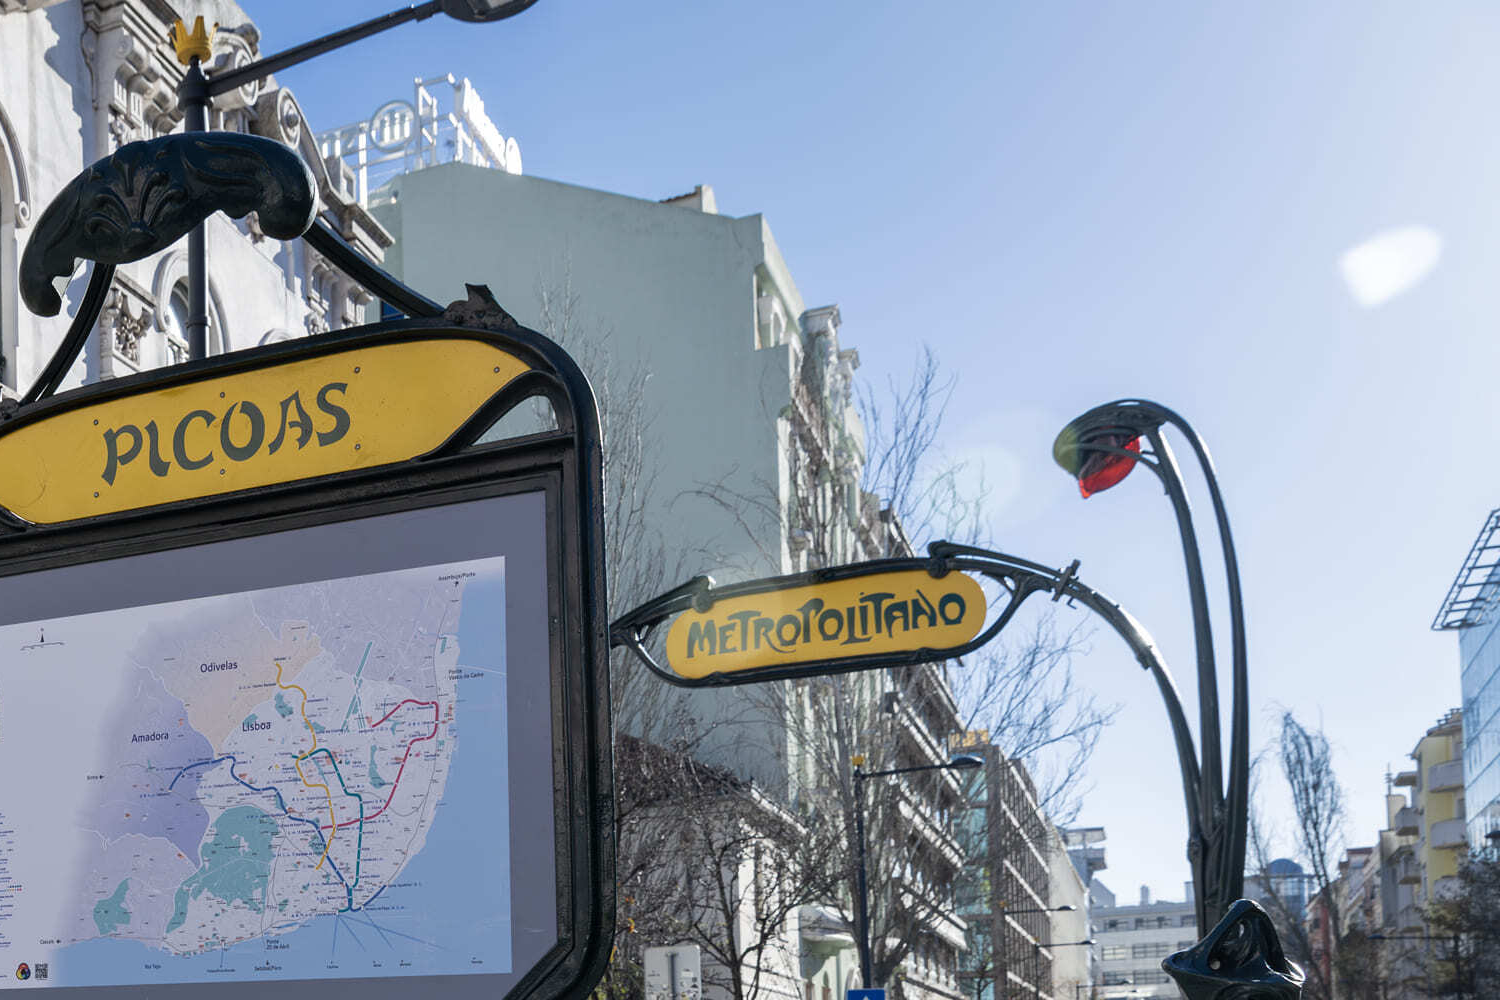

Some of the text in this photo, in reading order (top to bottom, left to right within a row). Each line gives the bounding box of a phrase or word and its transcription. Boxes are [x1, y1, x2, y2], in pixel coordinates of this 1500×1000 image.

[100, 382, 351, 487] PICOAS
[686, 589, 967, 659] METROPOLITANO
[200, 661, 238, 673] Odivelas
[242, 720, 272, 732] Lisboa
[131, 732, 169, 743] Amadora
